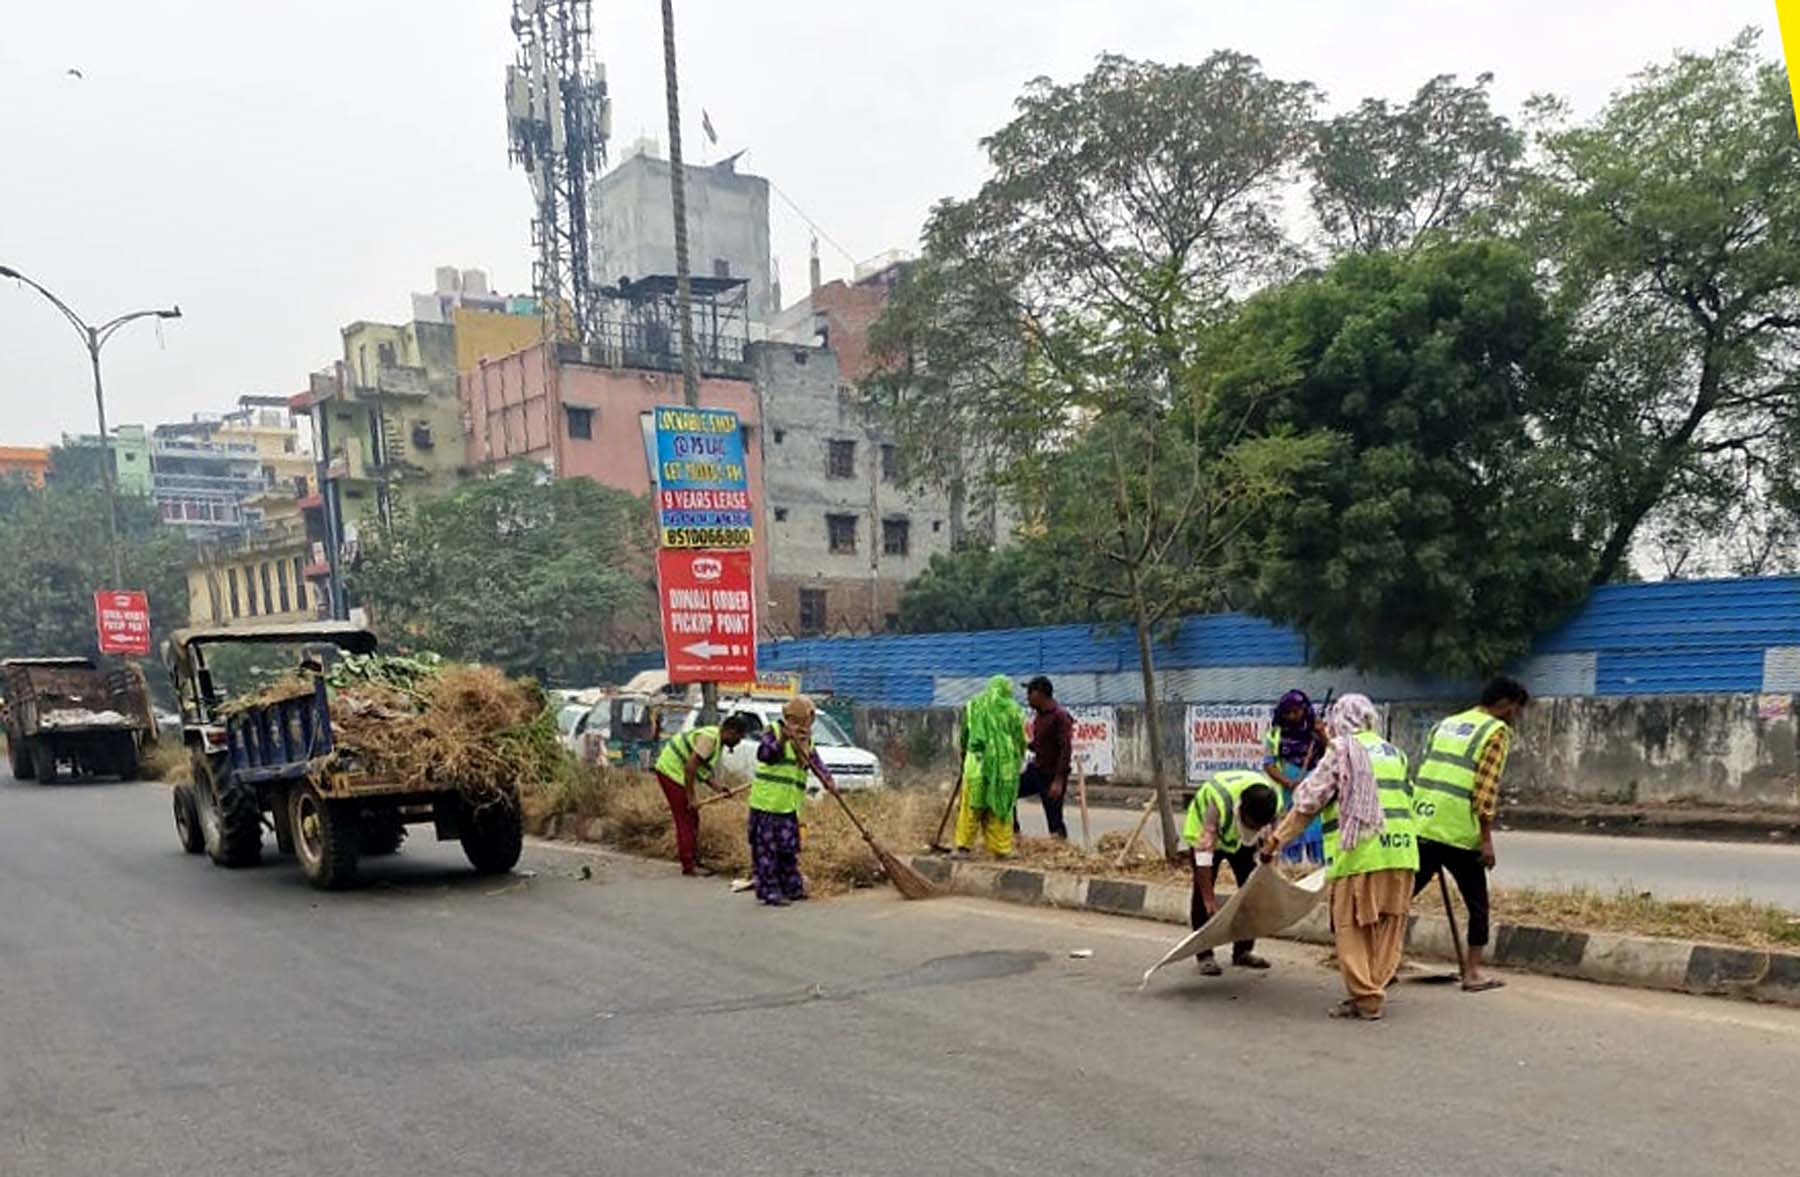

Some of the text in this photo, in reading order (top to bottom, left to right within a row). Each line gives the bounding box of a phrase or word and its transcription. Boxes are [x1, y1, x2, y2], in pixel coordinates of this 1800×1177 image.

[665, 491, 747, 510] 9 YEARS LEASE
[669, 589, 749, 611] DIWALI ORDER
[671, 612, 750, 635] PICKUP POINT
[1380, 834, 1410, 848] MCG
